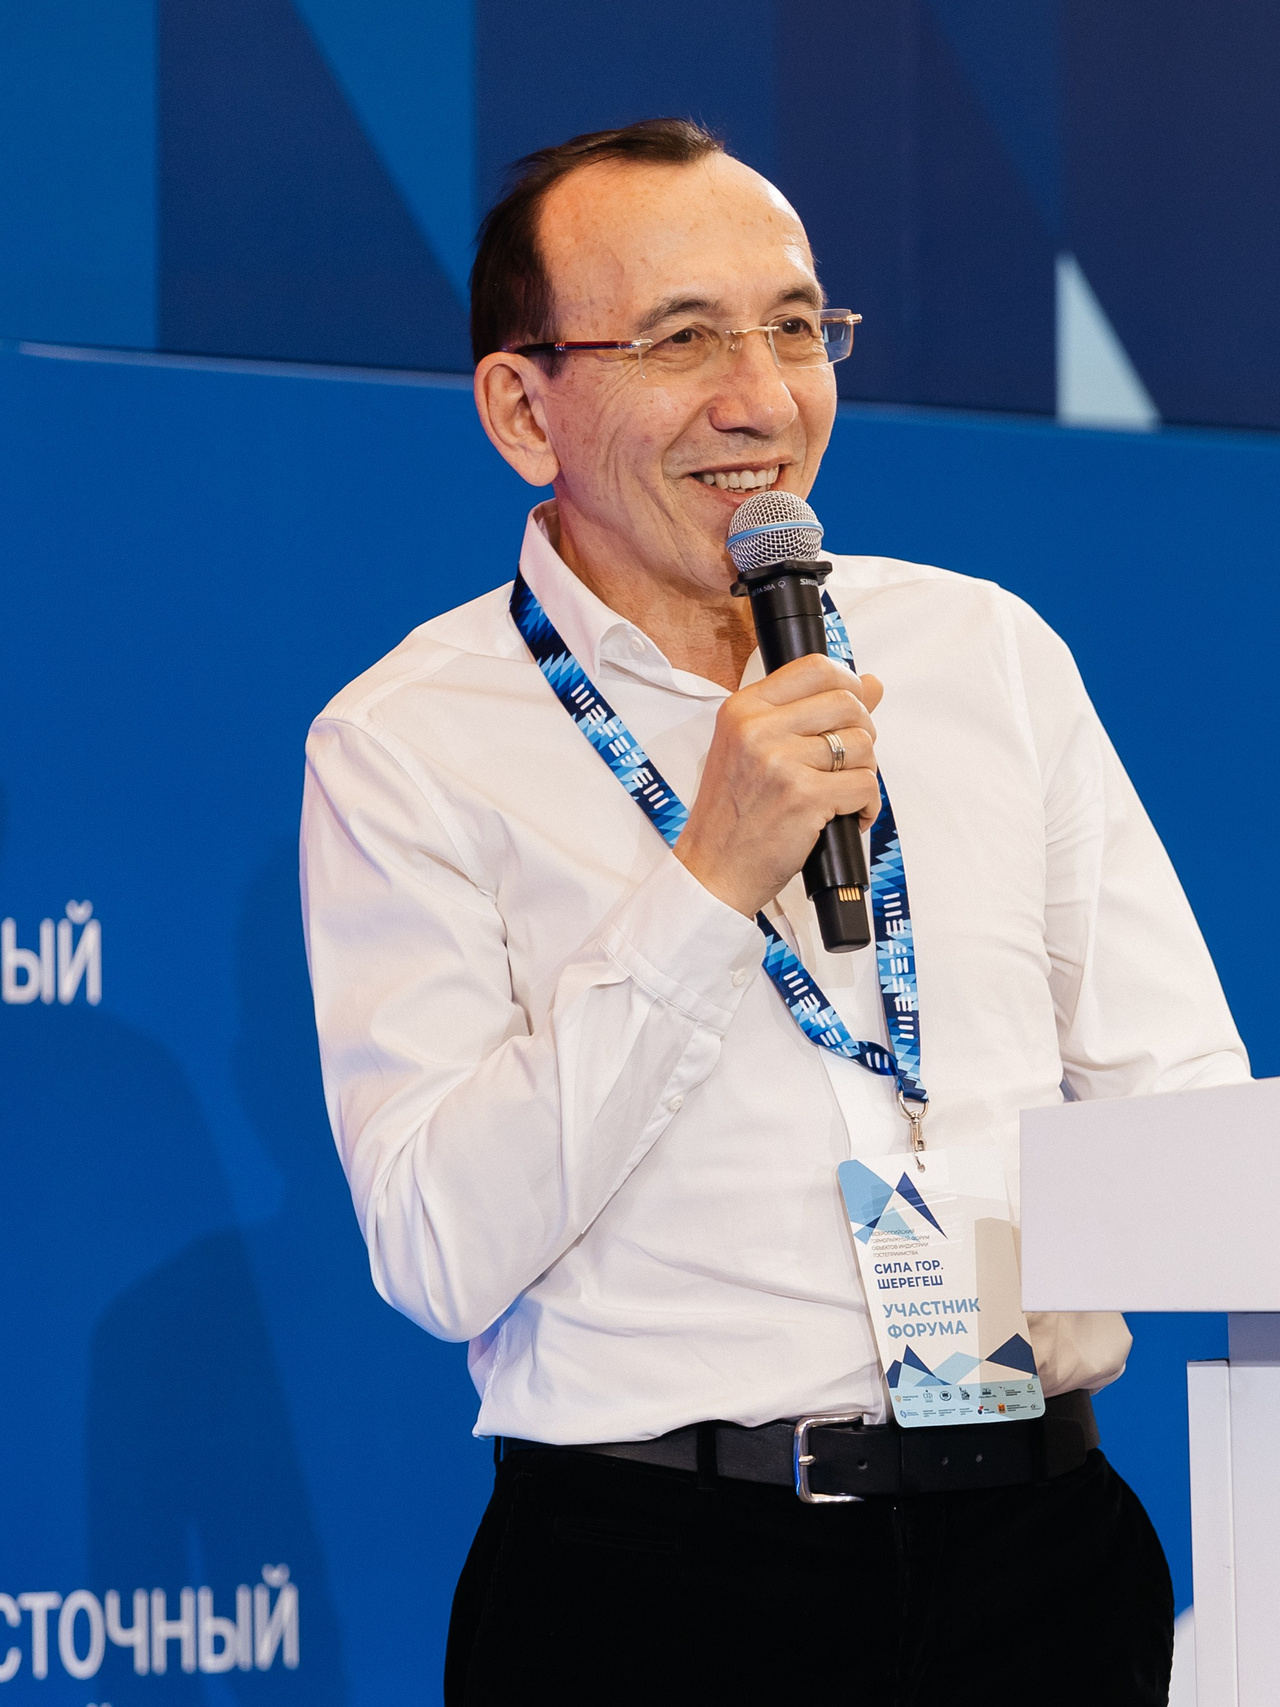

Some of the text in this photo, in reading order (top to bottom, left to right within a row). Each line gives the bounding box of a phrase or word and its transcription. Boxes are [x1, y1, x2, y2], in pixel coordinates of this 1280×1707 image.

[874, 1260, 944, 1274] СИЛА ГОР.
[877, 1275, 944, 1290] ШЕРЕГЕШ
[882, 1297, 981, 1318] УЧАСТНИК
[887, 1320, 968, 1339] ФОРУМА
